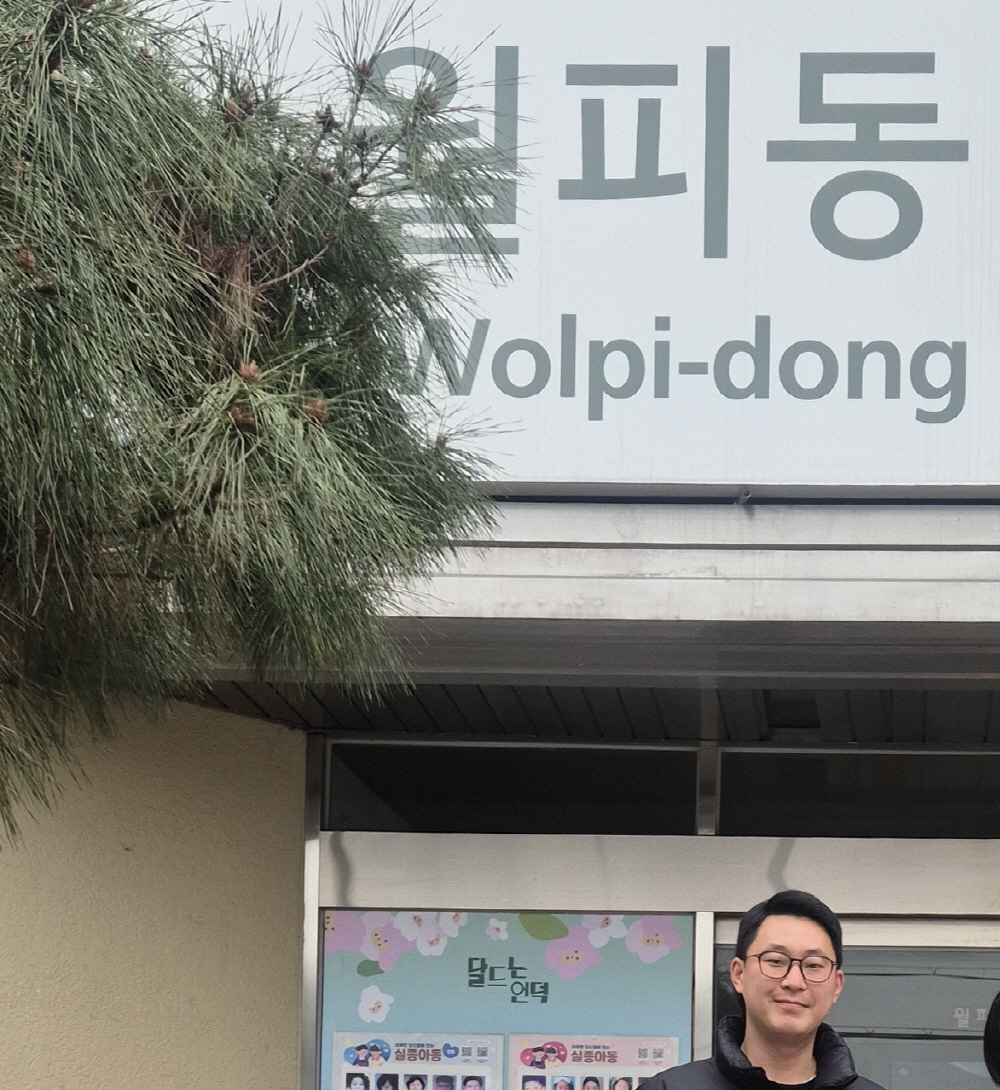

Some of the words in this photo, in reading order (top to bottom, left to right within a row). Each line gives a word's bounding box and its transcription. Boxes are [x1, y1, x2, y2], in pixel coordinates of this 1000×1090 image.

[363, 45, 969, 261] 월피동
[467, 956, 528, 988] 달드는
[509, 980, 550, 1003] 언덕
[394, 1047, 442, 1062] 실종아동
[571, 1050, 618, 1064] 실종아동
